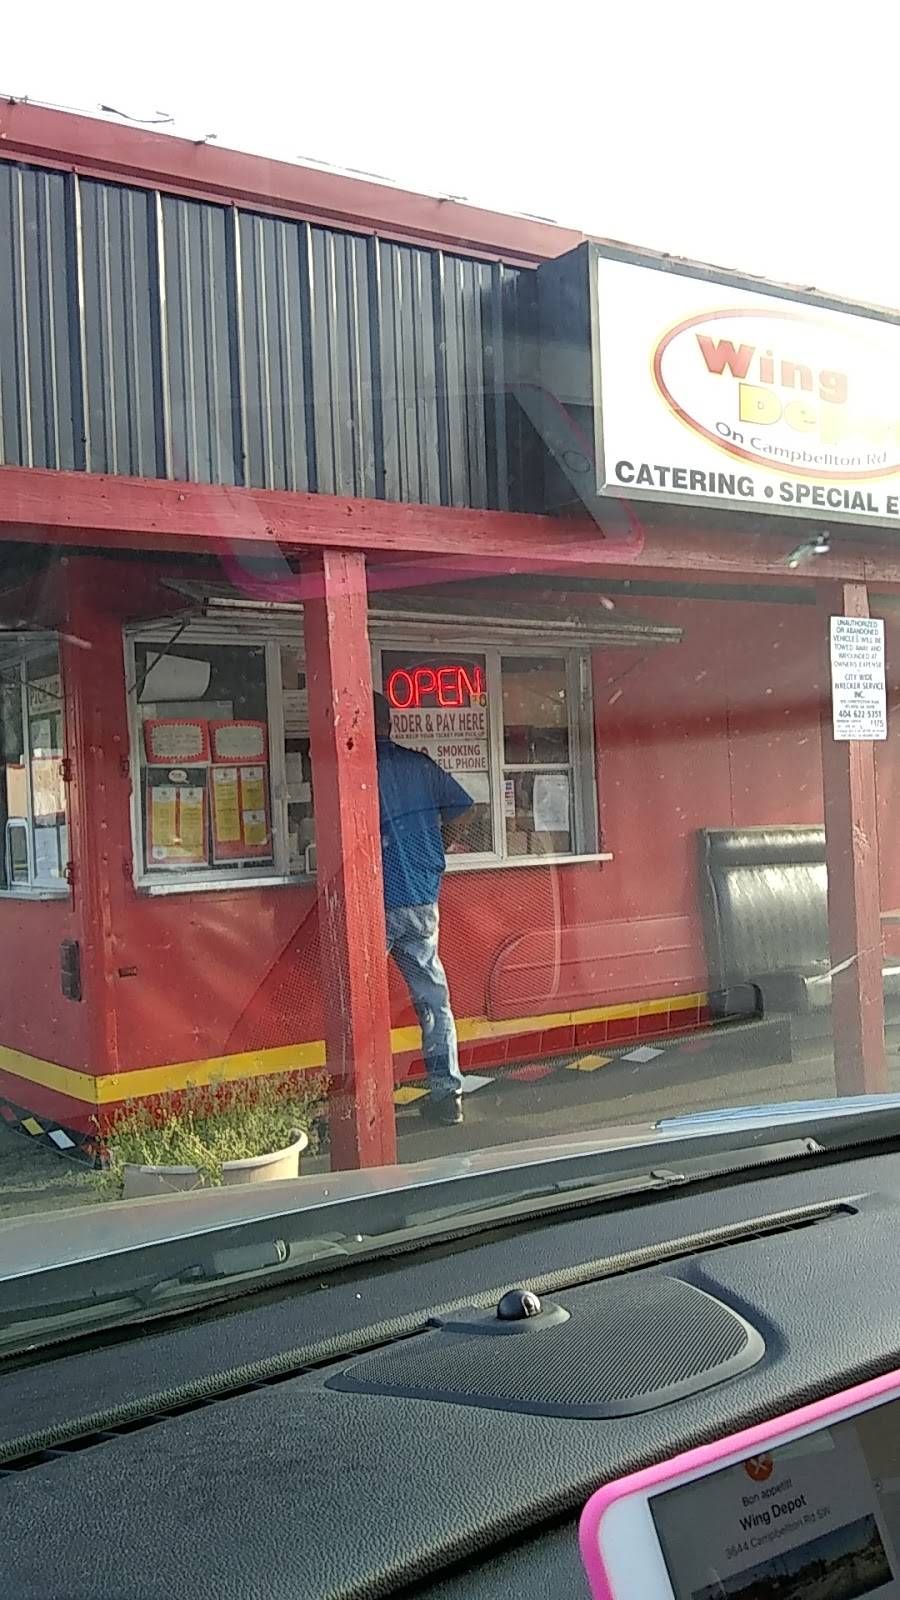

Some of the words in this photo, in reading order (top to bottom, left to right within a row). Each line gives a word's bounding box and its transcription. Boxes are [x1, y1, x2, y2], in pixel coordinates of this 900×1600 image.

[695, 334, 848, 404] Wing
[715, 421, 744, 444] On
[750, 437, 861, 467] Campbellton
[614, 460, 754, 498] CATERING
[779, 481, 879, 513] SPECIAL
[886, 495, 899, 515] E
[387, 667, 481, 709] OPEN
[393, 714, 422, 733] RDER
[425, 714, 433, 731] &
[436, 713, 456, 731] PAY
[459, 712, 484, 731] HERE
[437, 745, 480, 757] SMOKING
[439, 759, 454, 769] ELL
[456, 757, 486, 769] PHONE
[739, 1511, 771, 1531] Wing
[771, 1494, 807, 1519] Depot
[742, 1495, 760, 1507] Bon
